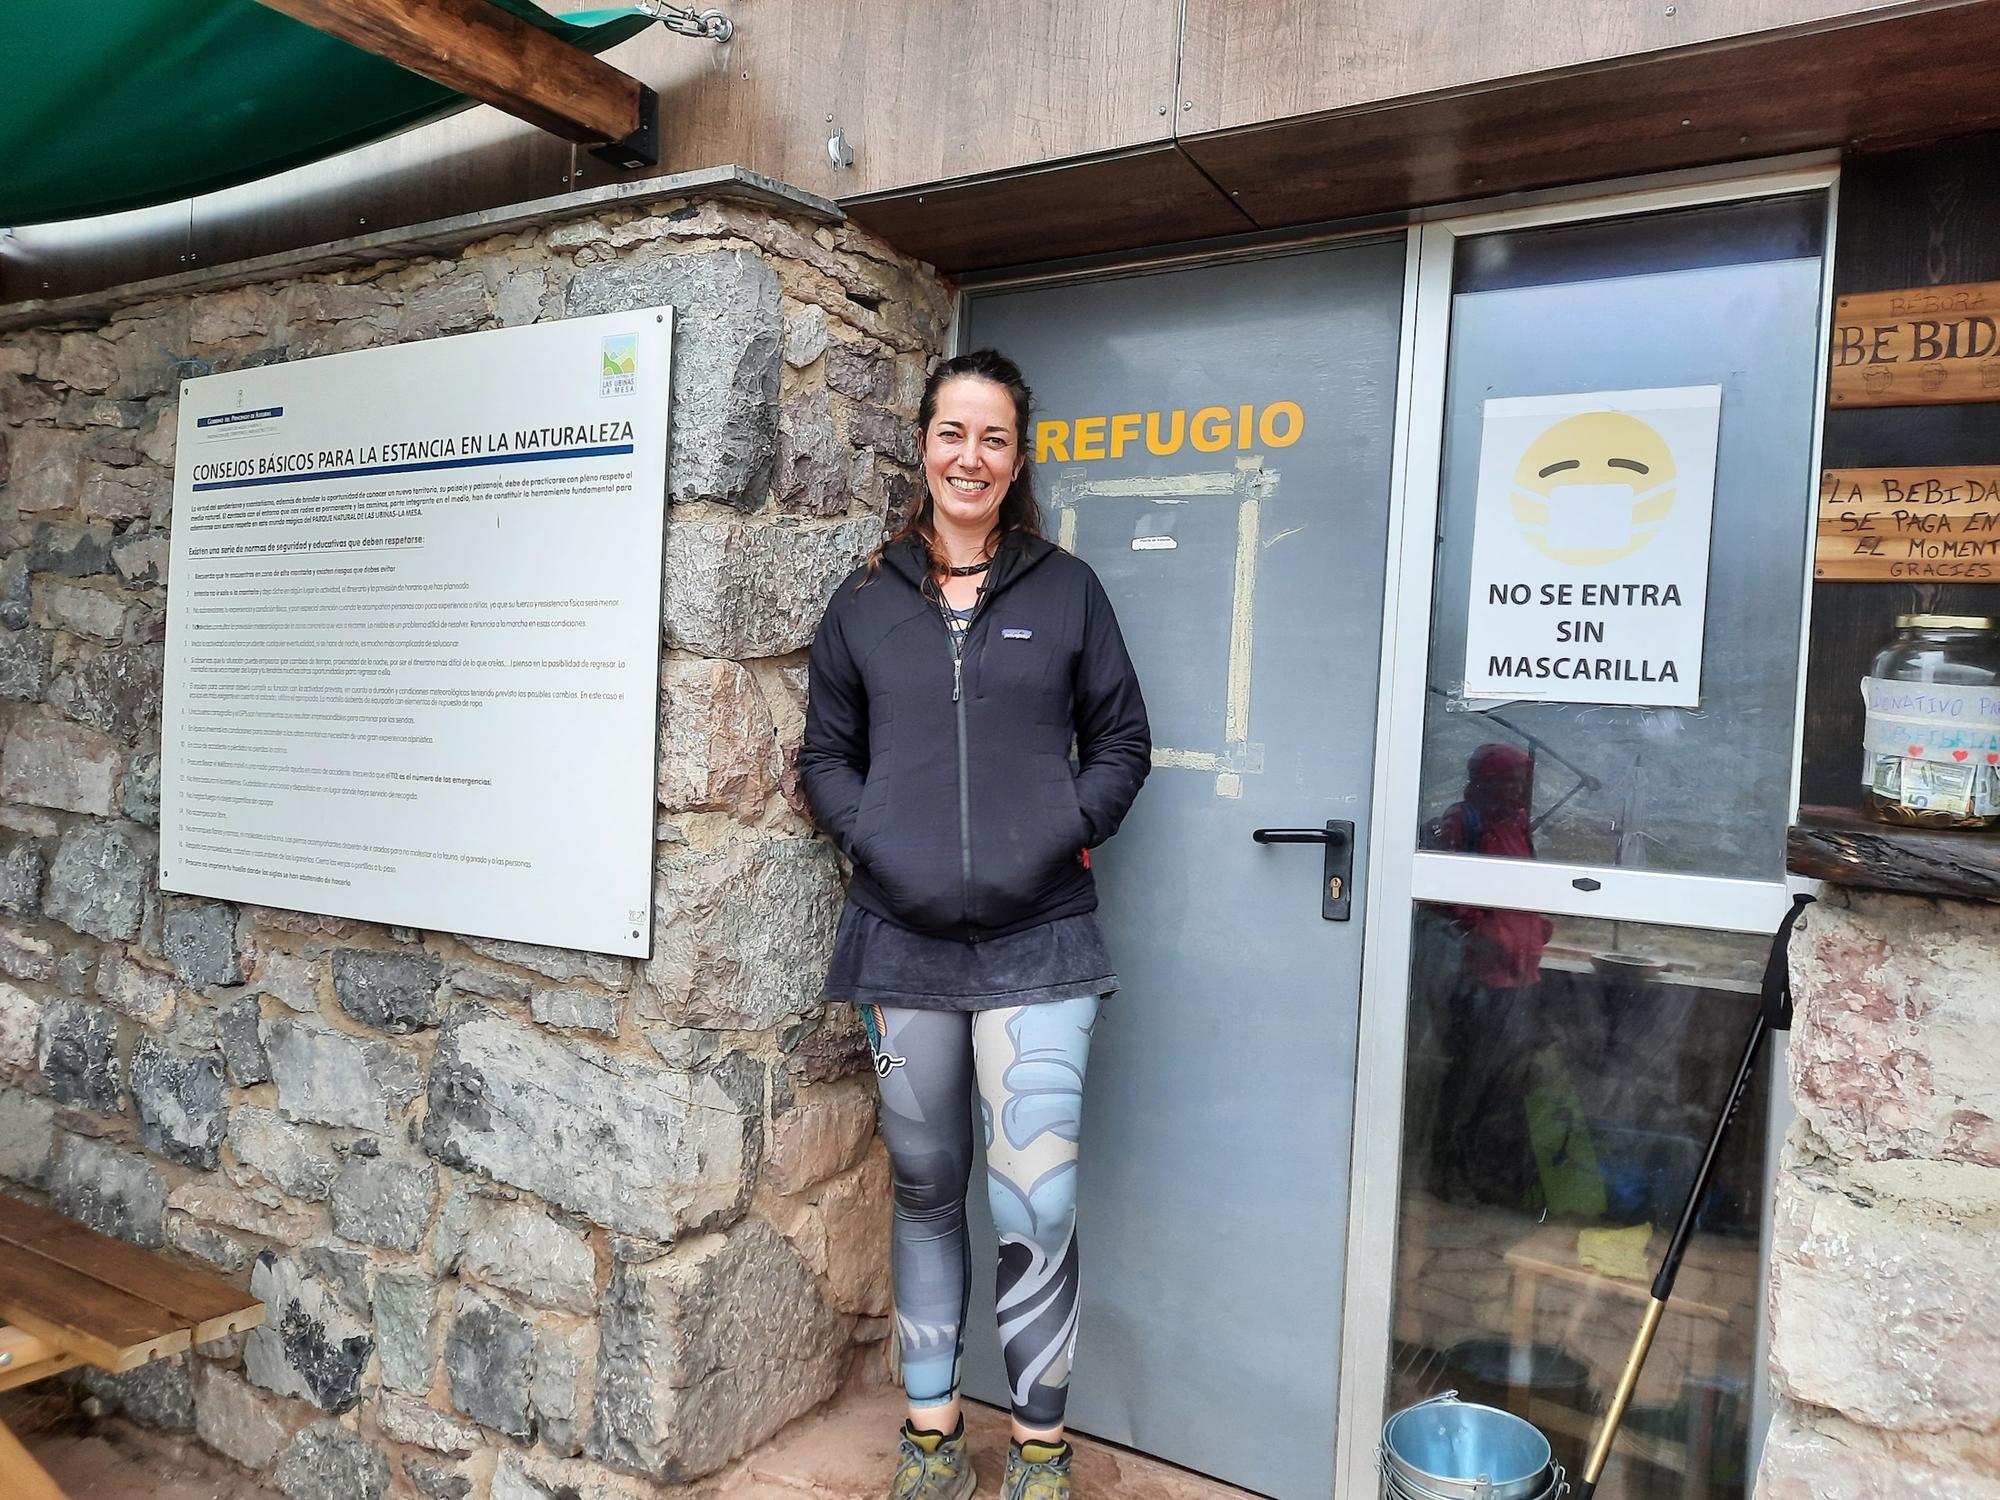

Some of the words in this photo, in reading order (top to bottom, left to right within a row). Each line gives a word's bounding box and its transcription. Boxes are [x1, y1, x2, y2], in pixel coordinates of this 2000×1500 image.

[1835, 316, 2000, 367] BEBID
[1035, 401, 1304, 464] REFUGIO
[192, 458, 255, 480] CONSEJOS
[258, 452, 314, 474] BÁSICOS
[318, 448, 355, 468] PARA
[359, 446, 378, 464] LA
[382, 438, 455, 462] ESTANCIA
[461, 435, 482, 455] EN
[487, 433, 508, 452] LA
[515, 420, 633, 450] NATURALEZA
[1829, 479, 1863, 503] LA
[1841, 512, 1880, 531] SE
[1892, 510, 1951, 533] PAGA
[267, 543, 275, 551] de
[276, 541, 307, 552] seguridad
[307, 542, 311, 551] y
[312, 539, 346, 549] educativas
[347, 540, 360, 549] que
[361, 537, 383, 546] deben
[384, 535, 424, 547] respetarse:
[1854, 536, 1885, 556] EL
[1891, 562, 1992, 578] GRACIES
[1489, 584, 1531, 605] NO
[1540, 584, 1573, 605] SE
[1582, 584, 1682, 606] ENTRA
[1556, 621, 1604, 642] SIN
[1488, 656, 1679, 682] MASCARILLA
